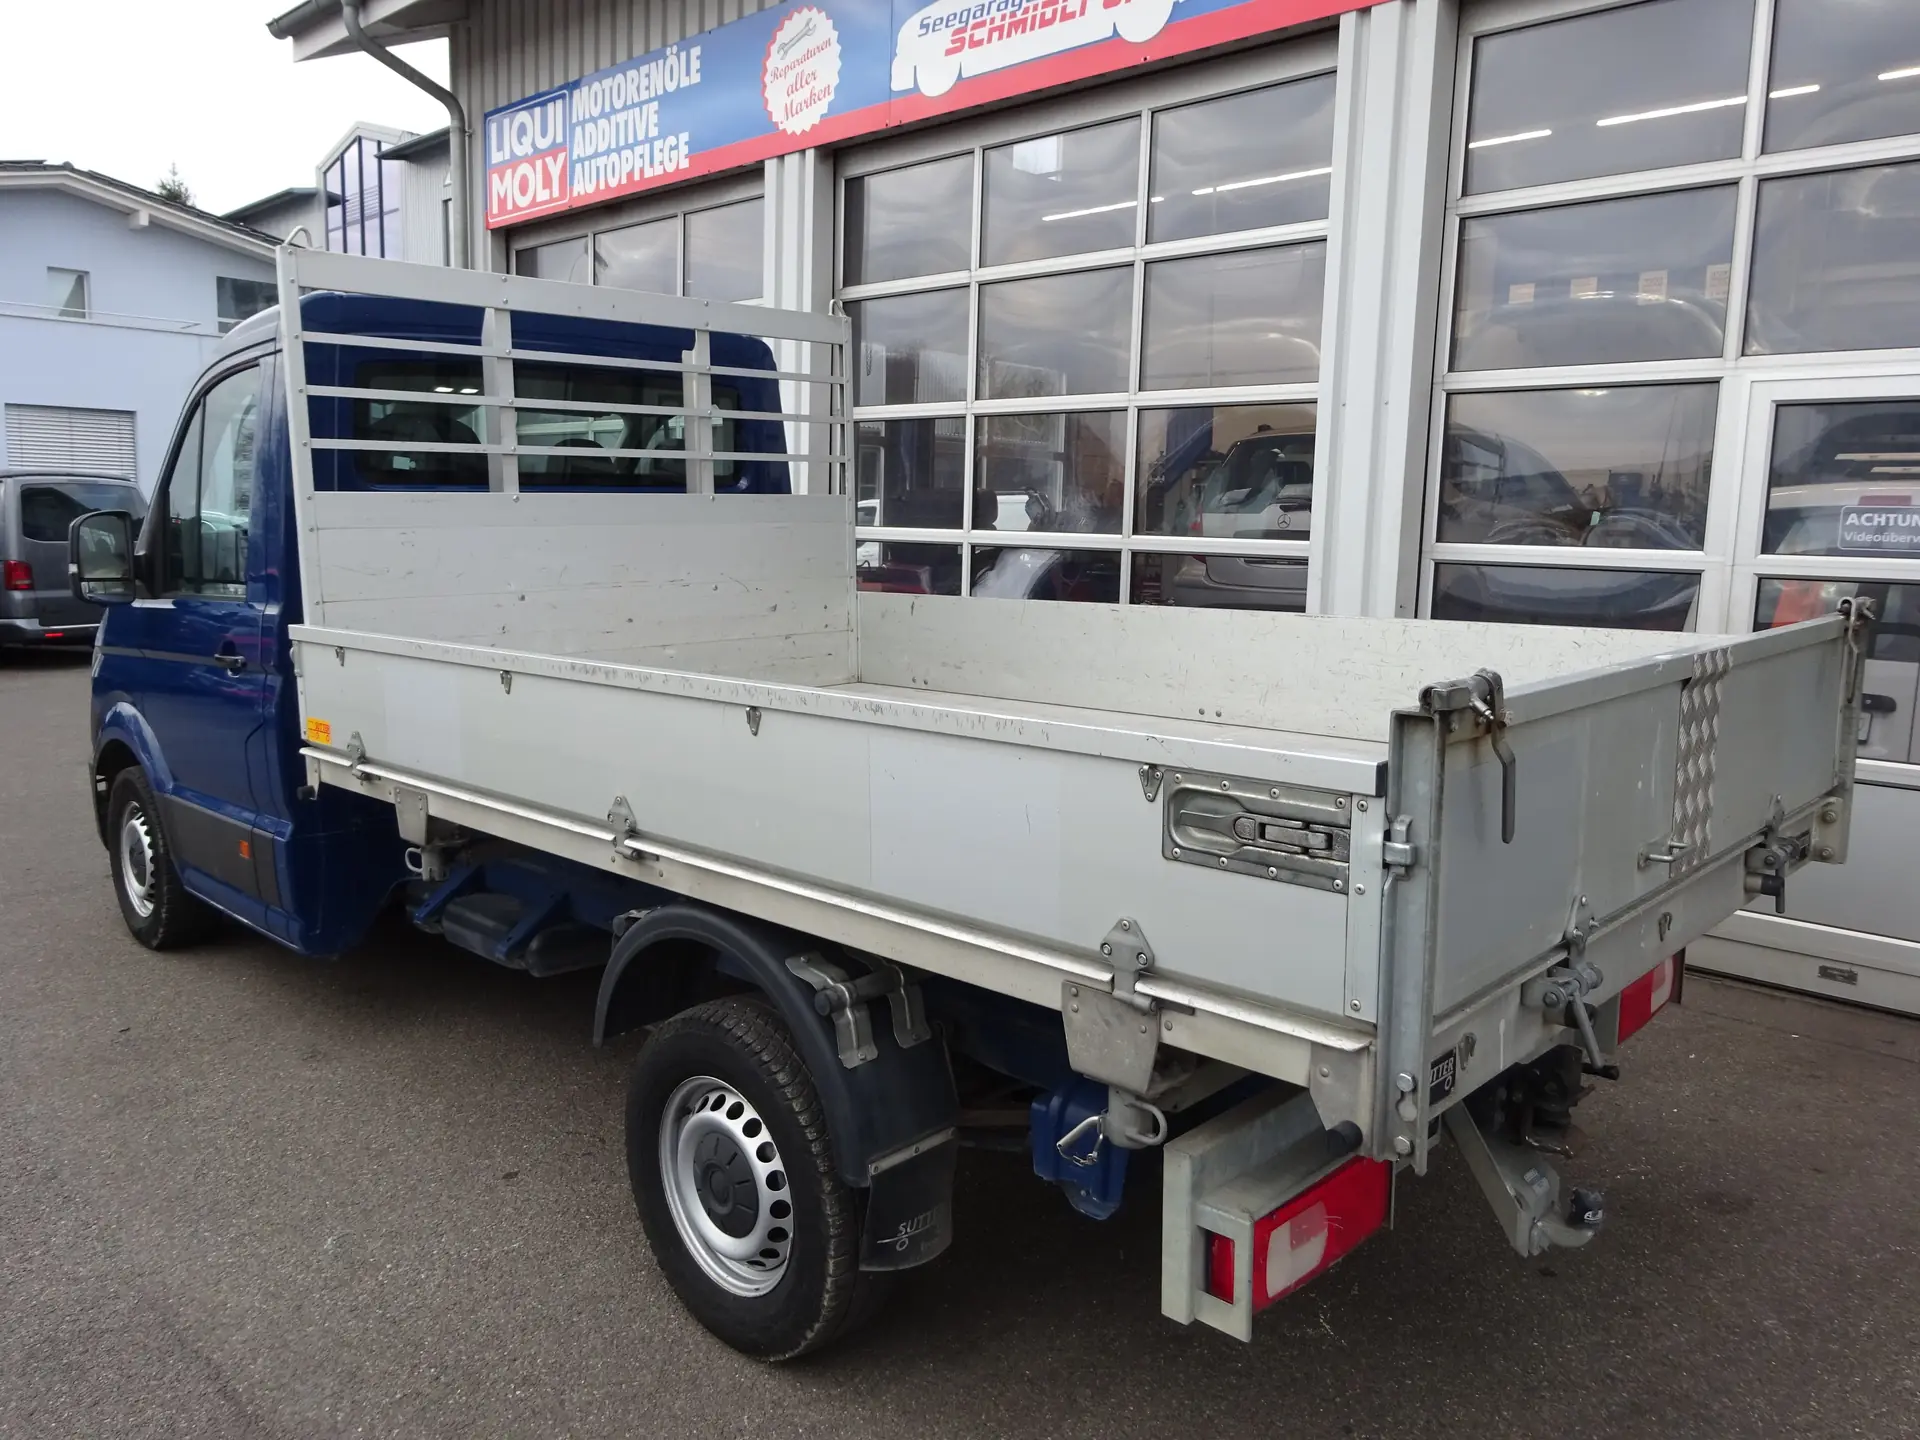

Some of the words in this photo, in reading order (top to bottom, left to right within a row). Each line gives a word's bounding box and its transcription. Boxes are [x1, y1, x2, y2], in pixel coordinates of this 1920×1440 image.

[918, 0, 1036, 37] Seegarag
[572, 45, 701, 123] MOTORENÖLE
[770, 37, 832, 84] Reparaturen
[786, 69, 818, 98] aller
[491, 99, 563, 165] LIQUI
[572, 101, 659, 160] ADDITIVE
[780, 84, 832, 124] Marken
[492, 152, 567, 215] MOLY
[572, 132, 690, 198] AUTOPFLEGE
